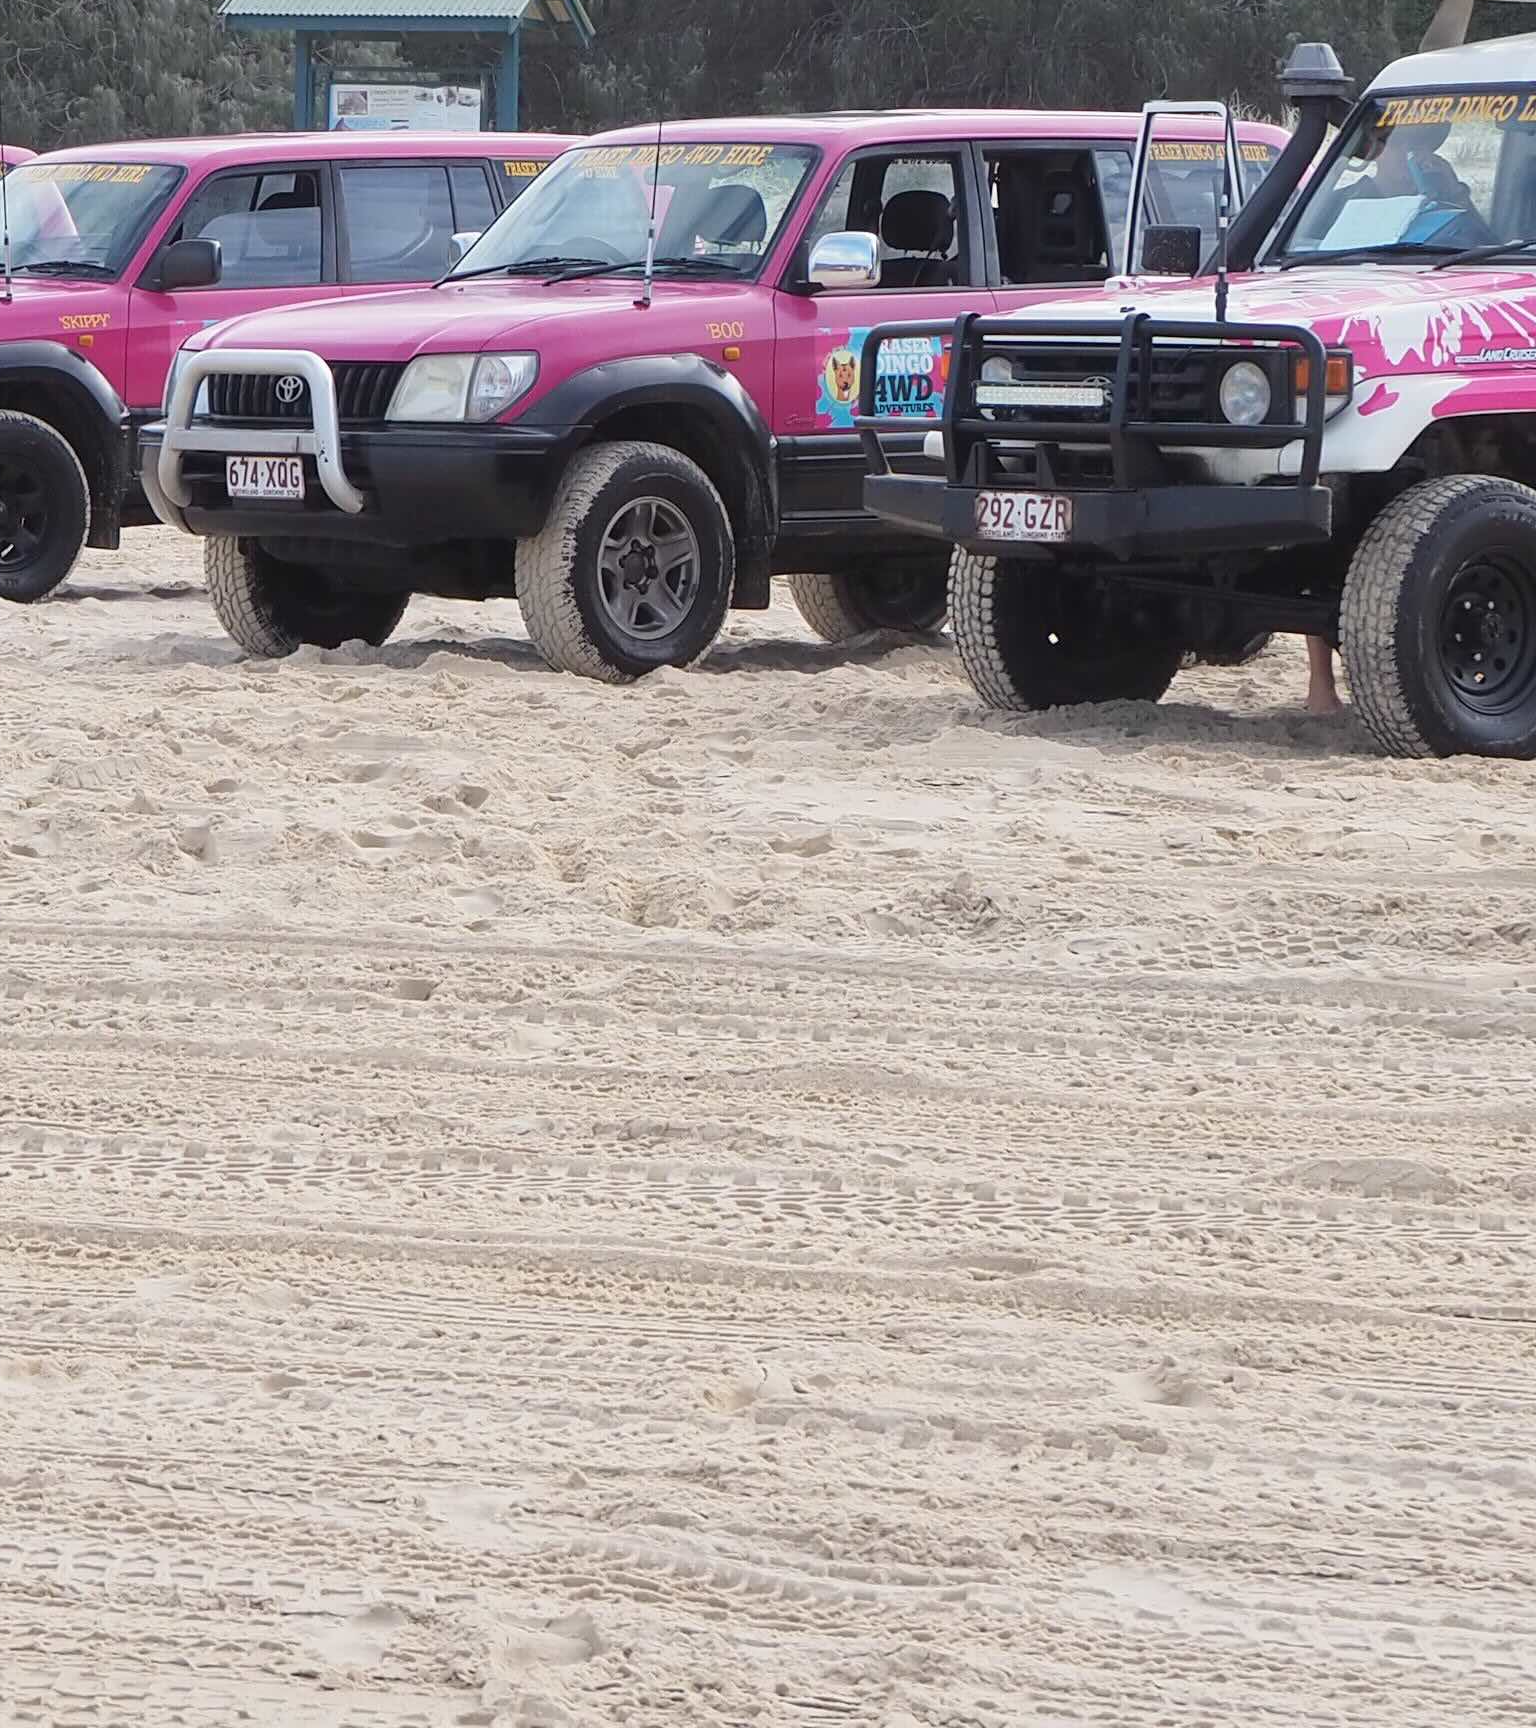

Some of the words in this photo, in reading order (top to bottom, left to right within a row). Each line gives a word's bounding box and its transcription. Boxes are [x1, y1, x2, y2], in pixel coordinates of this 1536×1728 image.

[1376, 96, 1453, 127] FRASER
[1451, 95, 1519, 122] DINGO
[720, 144, 774, 165] HIRE
[878, 338, 931, 353] RASER
[875, 374, 934, 402] 4WD
